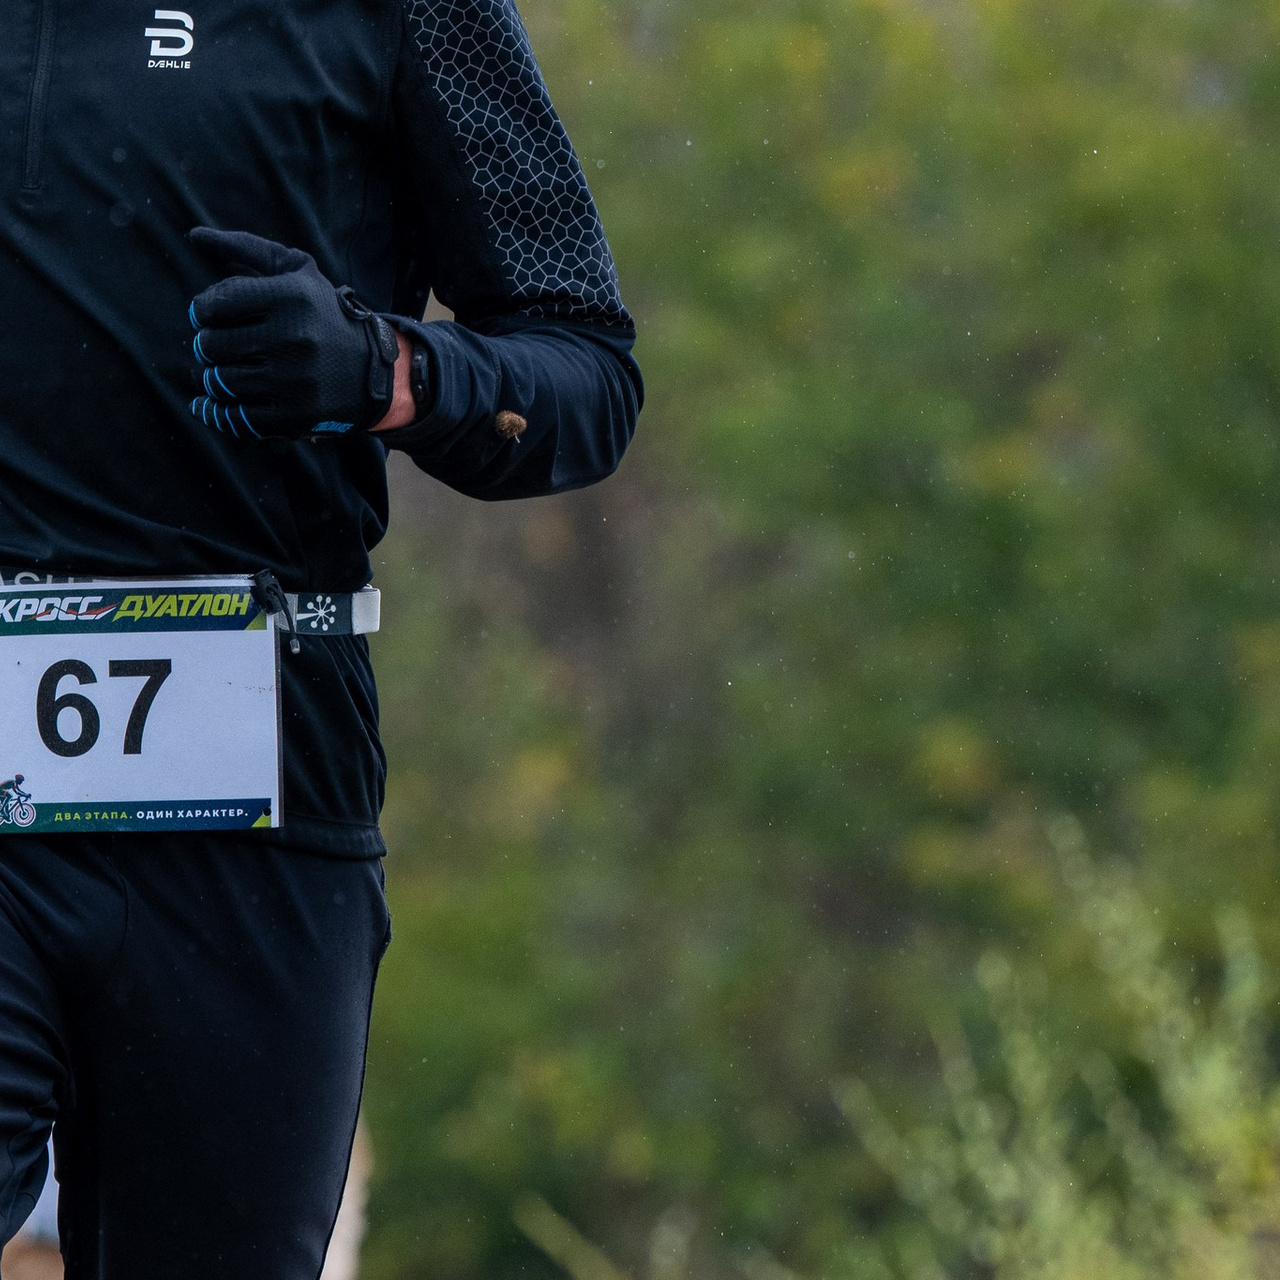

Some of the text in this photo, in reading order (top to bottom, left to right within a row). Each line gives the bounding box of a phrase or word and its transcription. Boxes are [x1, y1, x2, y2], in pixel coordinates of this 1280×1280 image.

[111, 593, 251, 623] ДУАТЛОН
[35, 658, 173, 758] 67
[54, 808, 249, 822] ДВА ЭТАПА. ОДИН ХАРАКТЕР.
